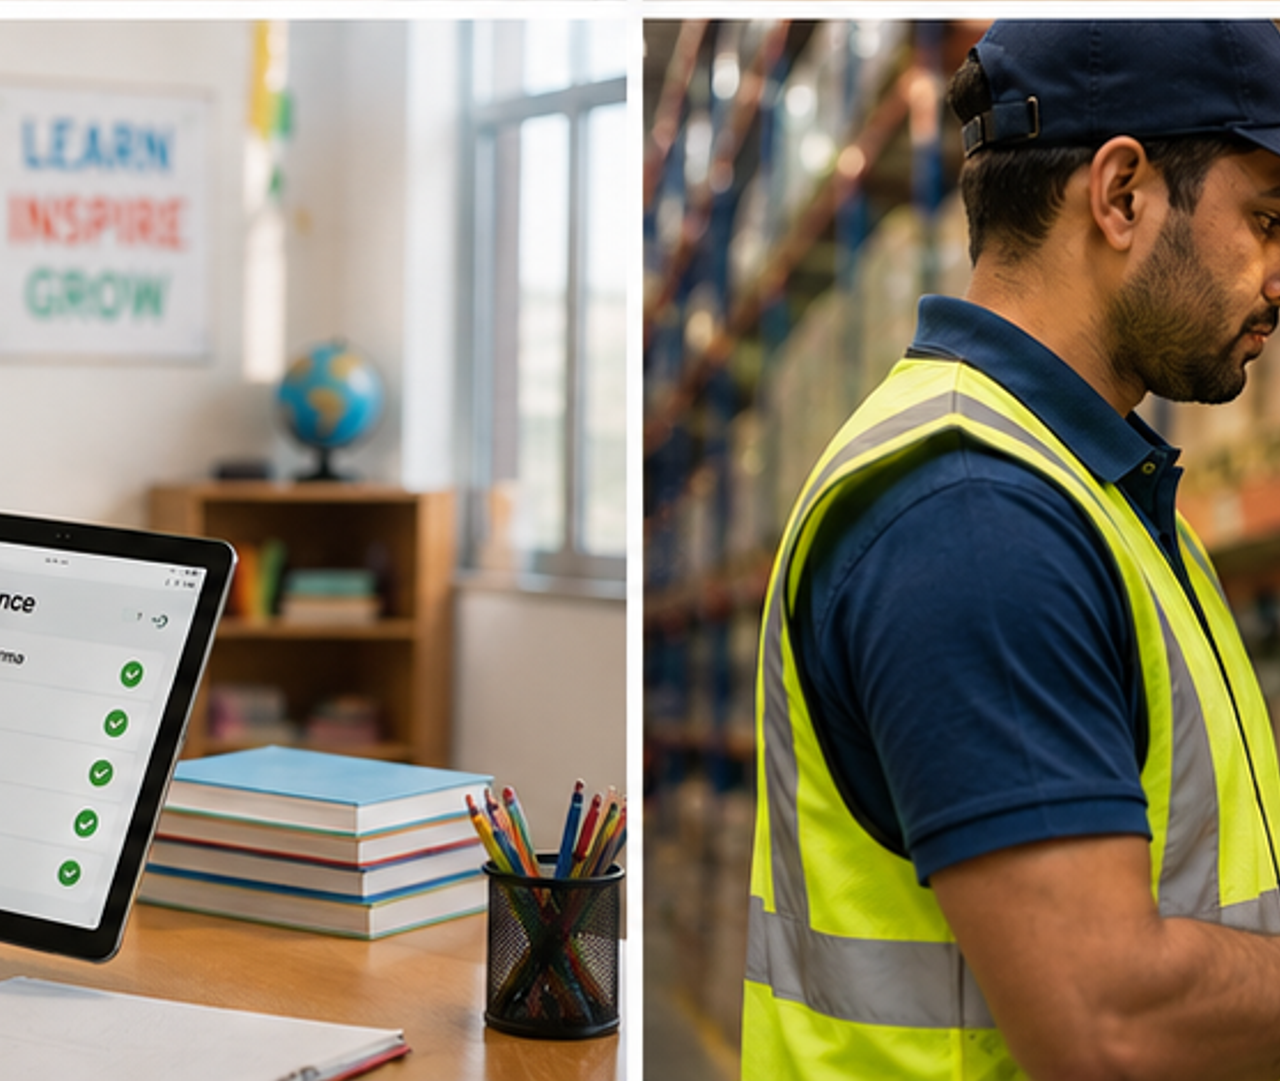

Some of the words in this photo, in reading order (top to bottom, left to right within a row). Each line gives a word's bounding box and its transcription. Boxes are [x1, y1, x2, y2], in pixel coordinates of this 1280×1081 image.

[21, 118, 174, 173] LEARN
[8, 192, 189, 253] INSPIRE
[24, 267, 173, 322] GROW
